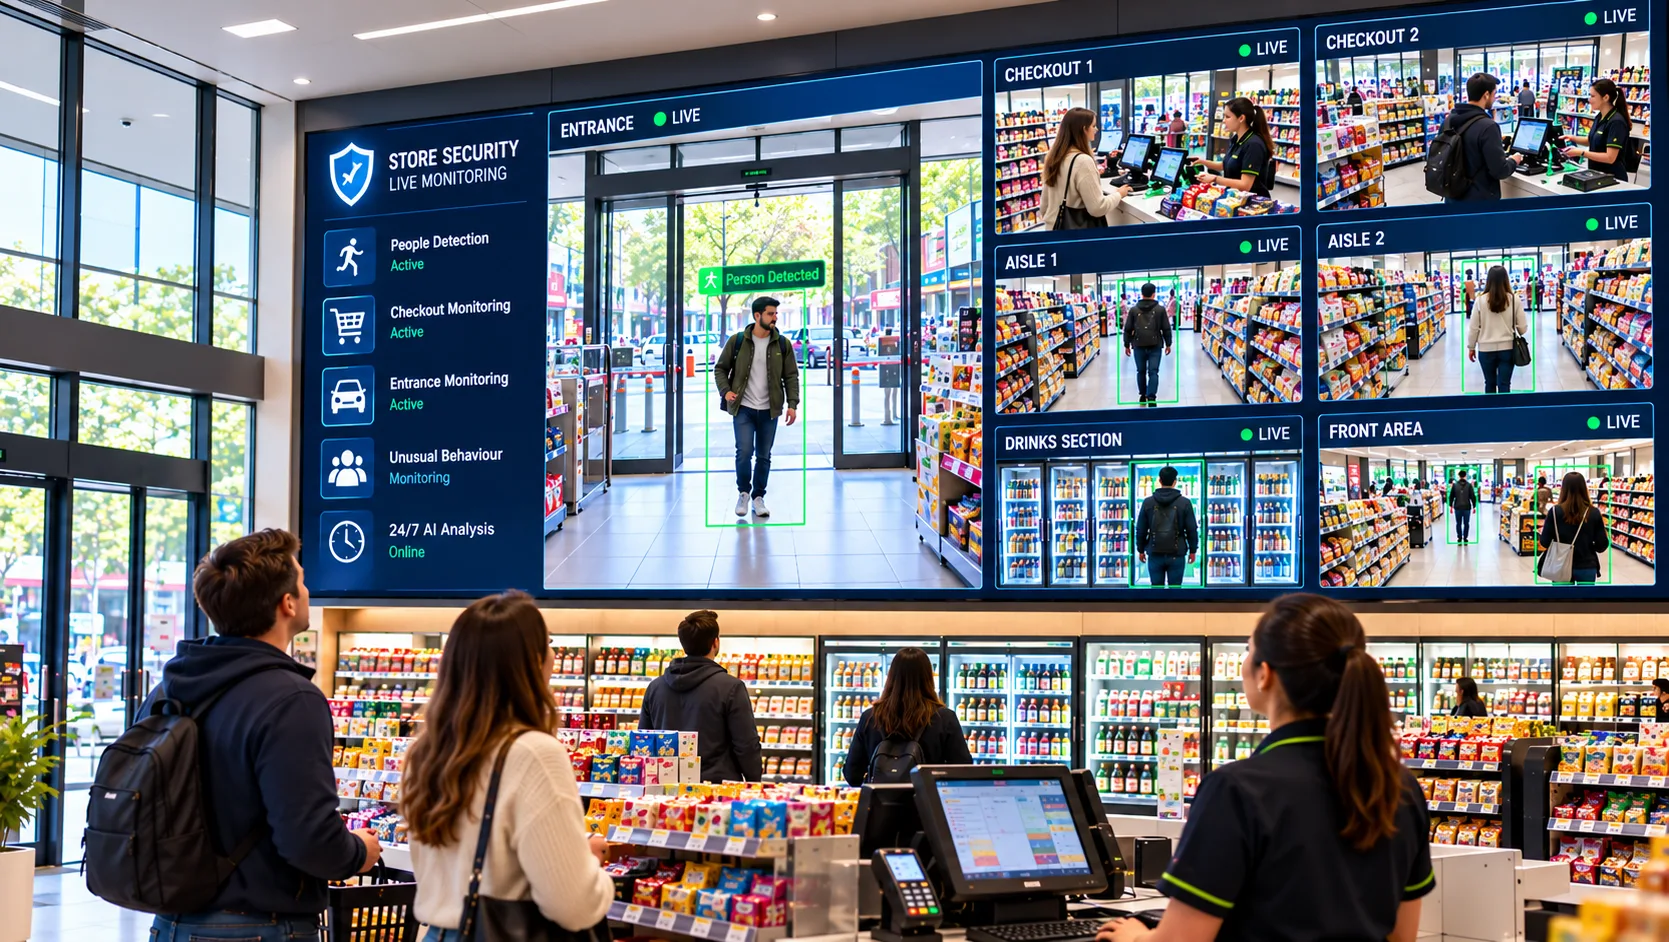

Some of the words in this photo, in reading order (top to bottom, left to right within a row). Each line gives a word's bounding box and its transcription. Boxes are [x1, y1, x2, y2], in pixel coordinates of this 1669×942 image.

[1604, 7, 1637, 24] LIVE
[1326, 28, 1406, 50] CHECKOUT
[1409, 26, 1419, 42] 2
[1257, 39, 1288, 56] LIVE
[1004, 60, 1082, 83] CHECKOUT
[1086, 59, 1093, 74] 1
[672, 107, 701, 125] LIVE
[561, 115, 634, 139] ENTRANCE
[388, 148, 438, 170] STORE
[442, 139, 520, 165] SECURITY
[389, 175, 418, 192] LIVE
[421, 165, 507, 188] MONITORING
[1605, 214, 1638, 231] LIVE
[391, 236, 430, 253] People
[433, 232, 489, 249] Detection
[1258, 237, 1289, 253] LIVE
[1327, 231, 1371, 249] AISLE
[1375, 230, 1385, 246] 2
[390, 258, 425, 272] Active
[1004, 253, 1046, 270] AISLE
[1050, 252, 1057, 267] 1
[726, 273, 765, 286] Person
[768, 267, 819, 283] Detected
[390, 303, 445, 319] Checkout
[447, 298, 511, 315] Monitoring
[389, 326, 424, 339] Active
[390, 376, 441, 390] Entrance
[444, 371, 509, 388] Monitoring
[389, 397, 424, 411] Active
[1329, 422, 1379, 440] FRONT
[1382, 421, 1424, 437] AREA
[1607, 414, 1641, 429] LIVE
[1005, 434, 1057, 451] DRINKS
[1061, 432, 1122, 449] SECTION
[1259, 426, 1290, 441] LIVE
[389, 449, 438, 464] Unusual
[441, 447, 504, 462] Behaviour
[389, 471, 450, 486] Monitoring
[389, 523, 420, 538] 24/7
[423, 522, 437, 536] AI
[440, 521, 495, 539] Analysis
[388, 545, 425, 559] Online
